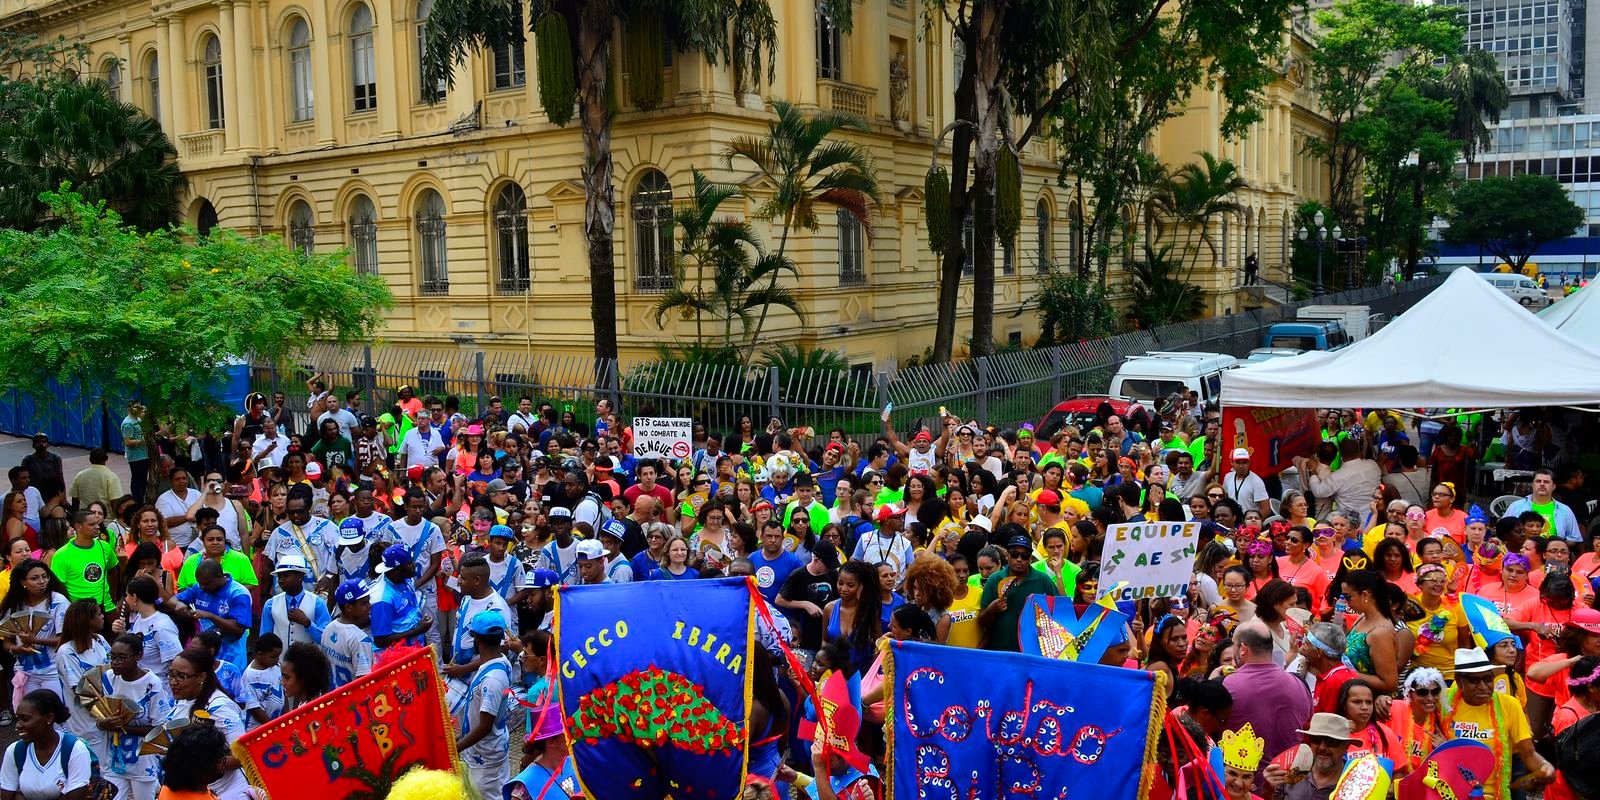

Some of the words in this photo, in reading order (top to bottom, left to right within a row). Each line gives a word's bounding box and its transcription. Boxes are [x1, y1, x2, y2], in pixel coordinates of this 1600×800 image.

[635, 418, 650, 426] STS
[652, 420, 670, 428] CASA
[650, 430, 678, 438] COMBATE
[635, 440, 672, 457] DENGUE
[1115, 524, 1195, 541] EQUIPE
[1100, 584, 1188, 600] UCURUVI
[562, 620, 629, 679] CECCO
[672, 621, 743, 675] IBIRA
[1461, 726, 1488, 739] Zika
